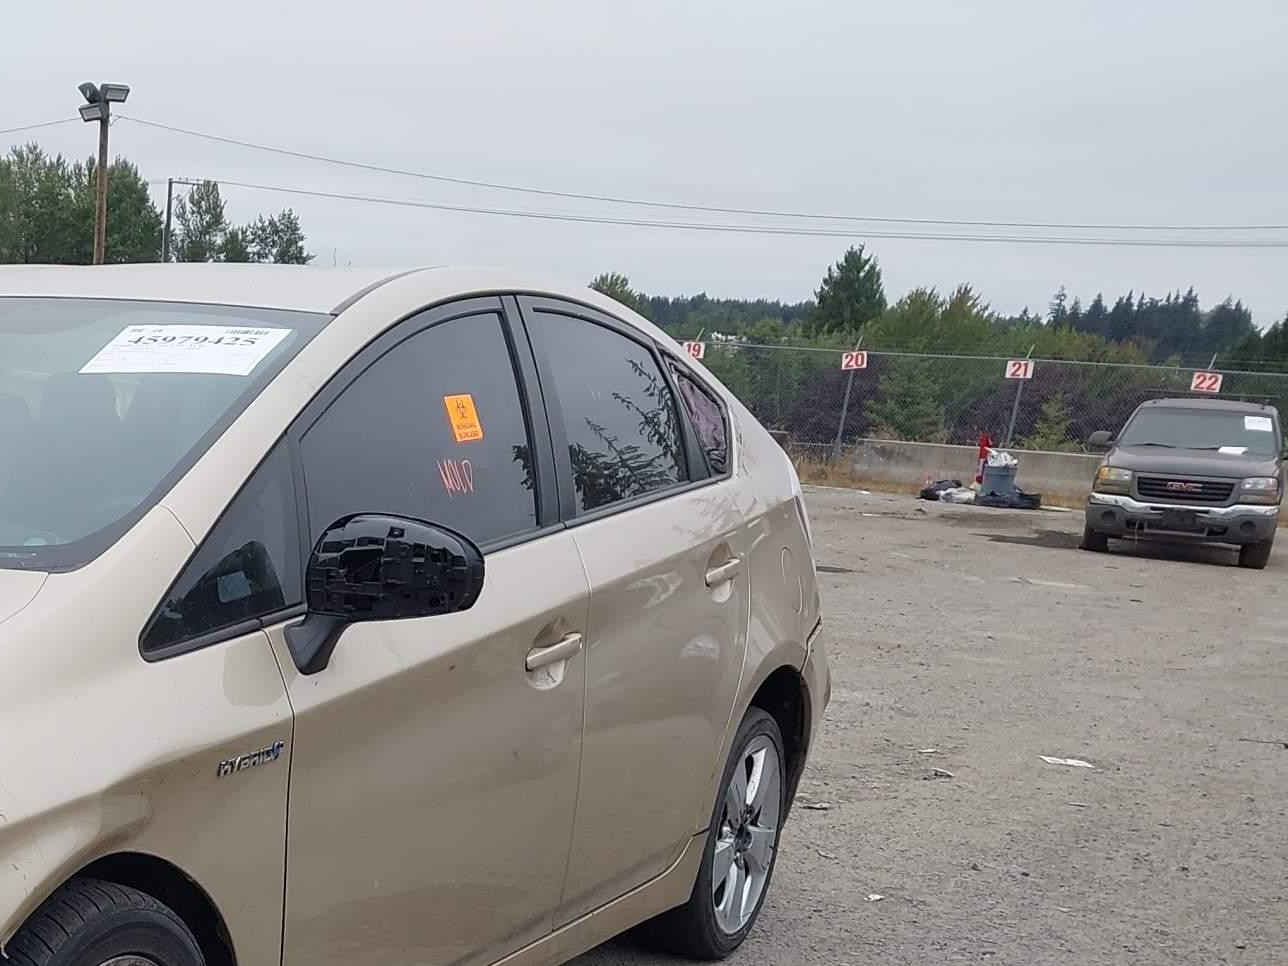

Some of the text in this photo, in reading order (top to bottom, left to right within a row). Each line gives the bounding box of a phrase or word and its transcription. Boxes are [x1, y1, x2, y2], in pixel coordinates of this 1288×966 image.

[127, 334, 260, 346] 45979425
[686, 343, 701, 356] 19
[844, 353, 864, 367] 20
[1010, 362, 1029, 377] 21
[1194, 374, 1219, 390] 22
